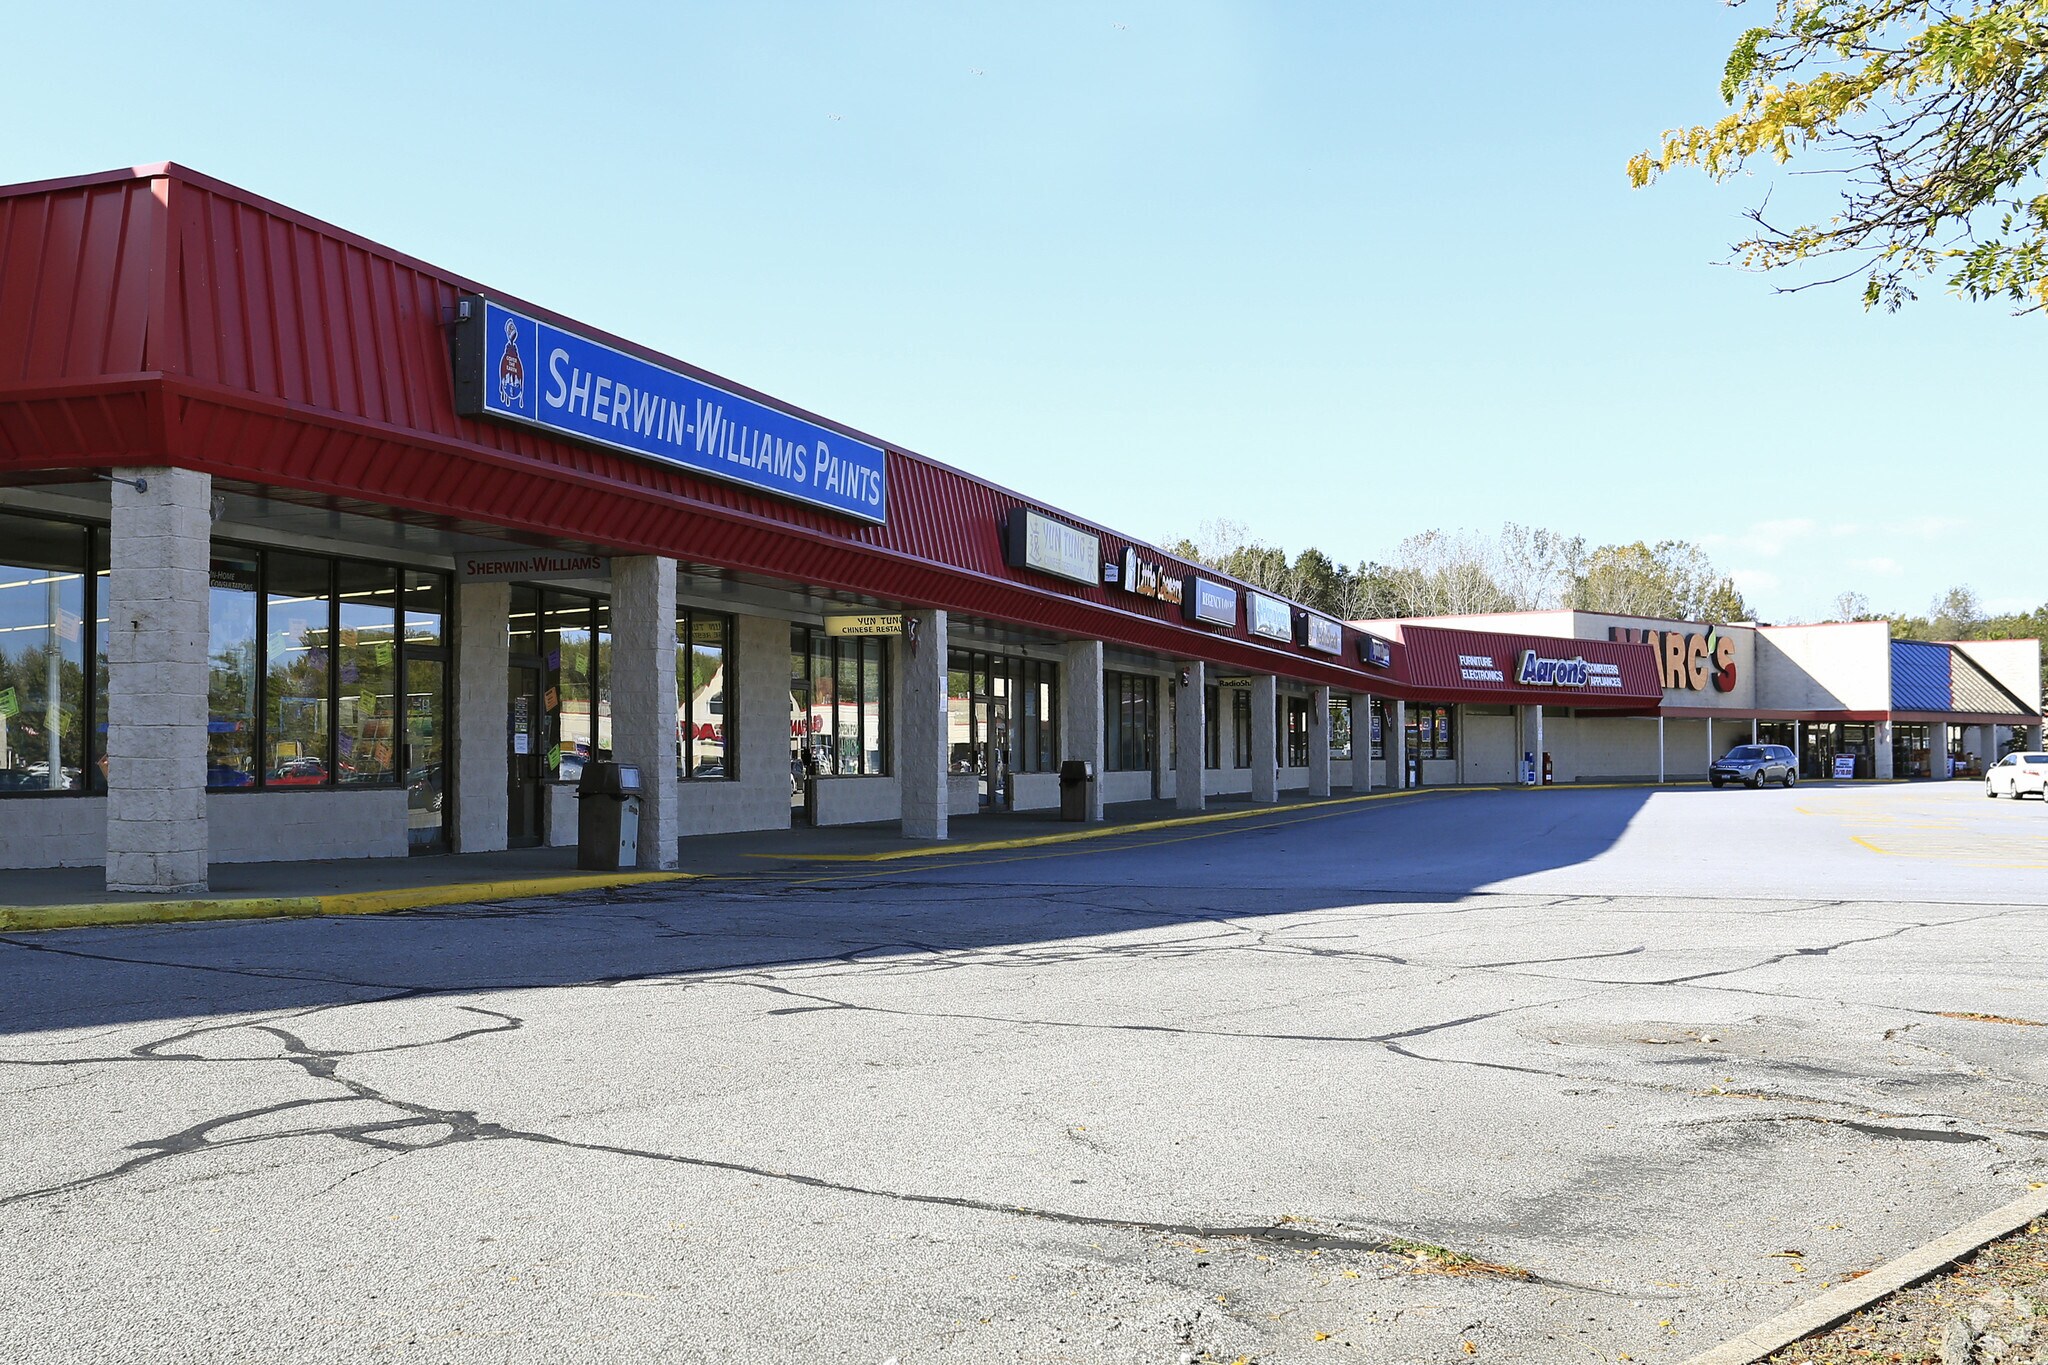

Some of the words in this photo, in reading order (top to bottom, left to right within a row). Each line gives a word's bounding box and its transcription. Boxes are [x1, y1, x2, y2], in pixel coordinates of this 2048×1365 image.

[813, 440, 881, 506] PAINTS
[1043, 522, 1061, 552] YUN
[467, 556, 601, 576] SHERWIN-WILLIAMS
[857, 617, 877, 626] YUN
[1459, 655, 1493, 668] FURNITURE
[1520, 650, 1588, 686] Aaron's
[1587, 662, 1619, 675] COMPUTERS
[1462, 669, 1504, 682] ELECTRONICS
[1589, 676, 1622, 688] APPLIANCES
